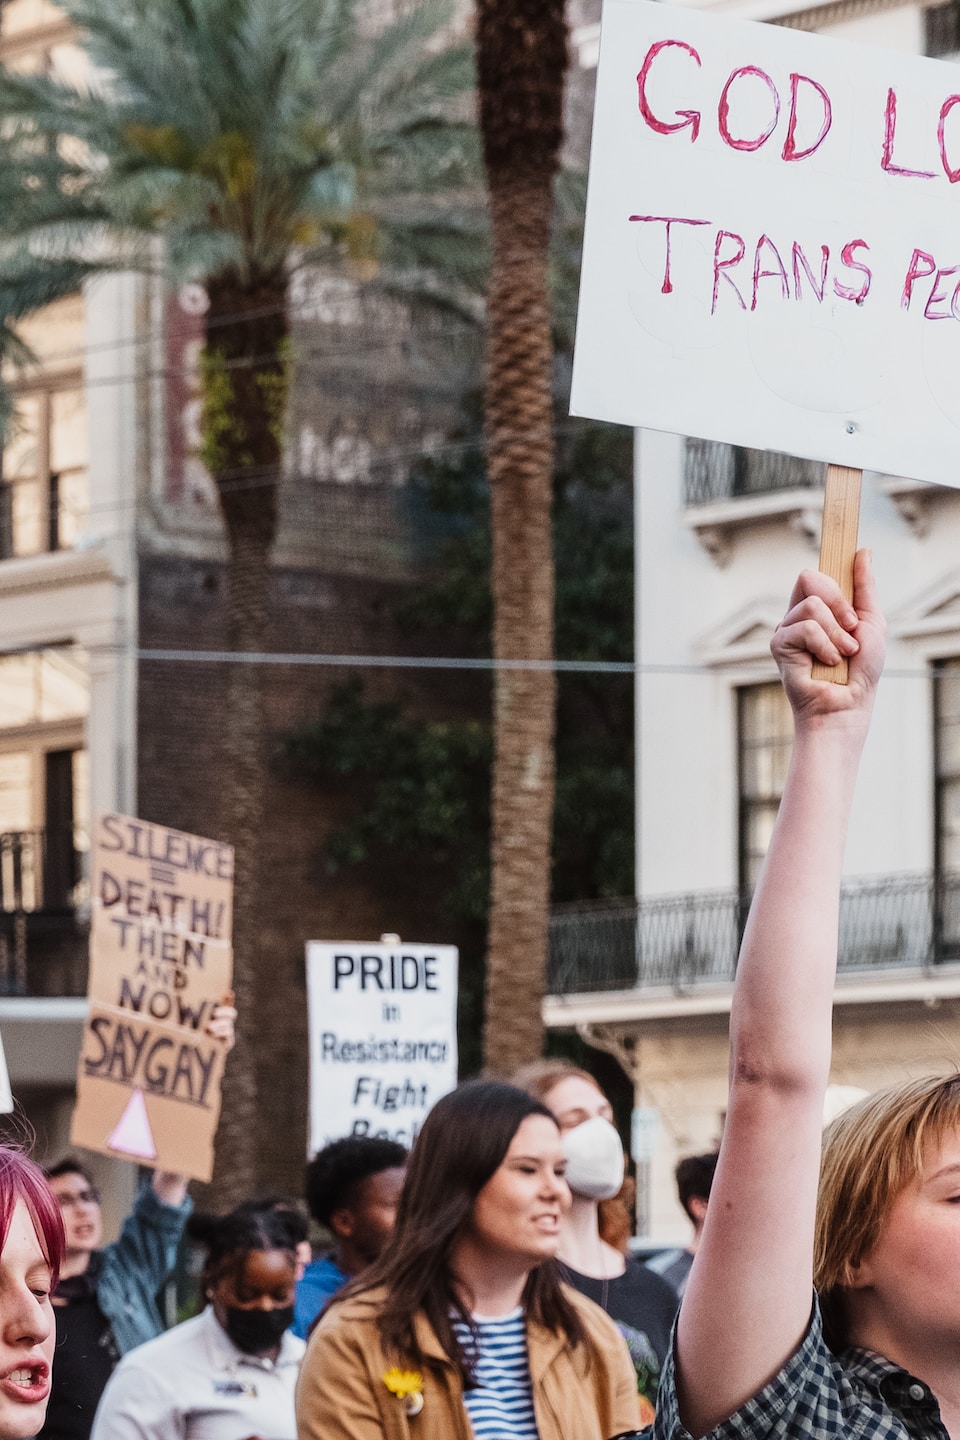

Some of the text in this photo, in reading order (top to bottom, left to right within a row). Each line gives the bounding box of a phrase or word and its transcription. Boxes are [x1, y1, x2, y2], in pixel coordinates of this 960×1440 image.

[637, 38, 833, 162] GOD
[628, 214, 960, 321] TRANS PE
[100, 815, 232, 879] SILENCE
[100, 870, 225, 939] DEATH!
[110, 918, 206, 968] THEN
[136, 961, 188, 990] AND
[333, 955, 439, 991] PRIDE
[382, 1003, 400, 1022] in
[353, 1077, 428, 1111] Fight
